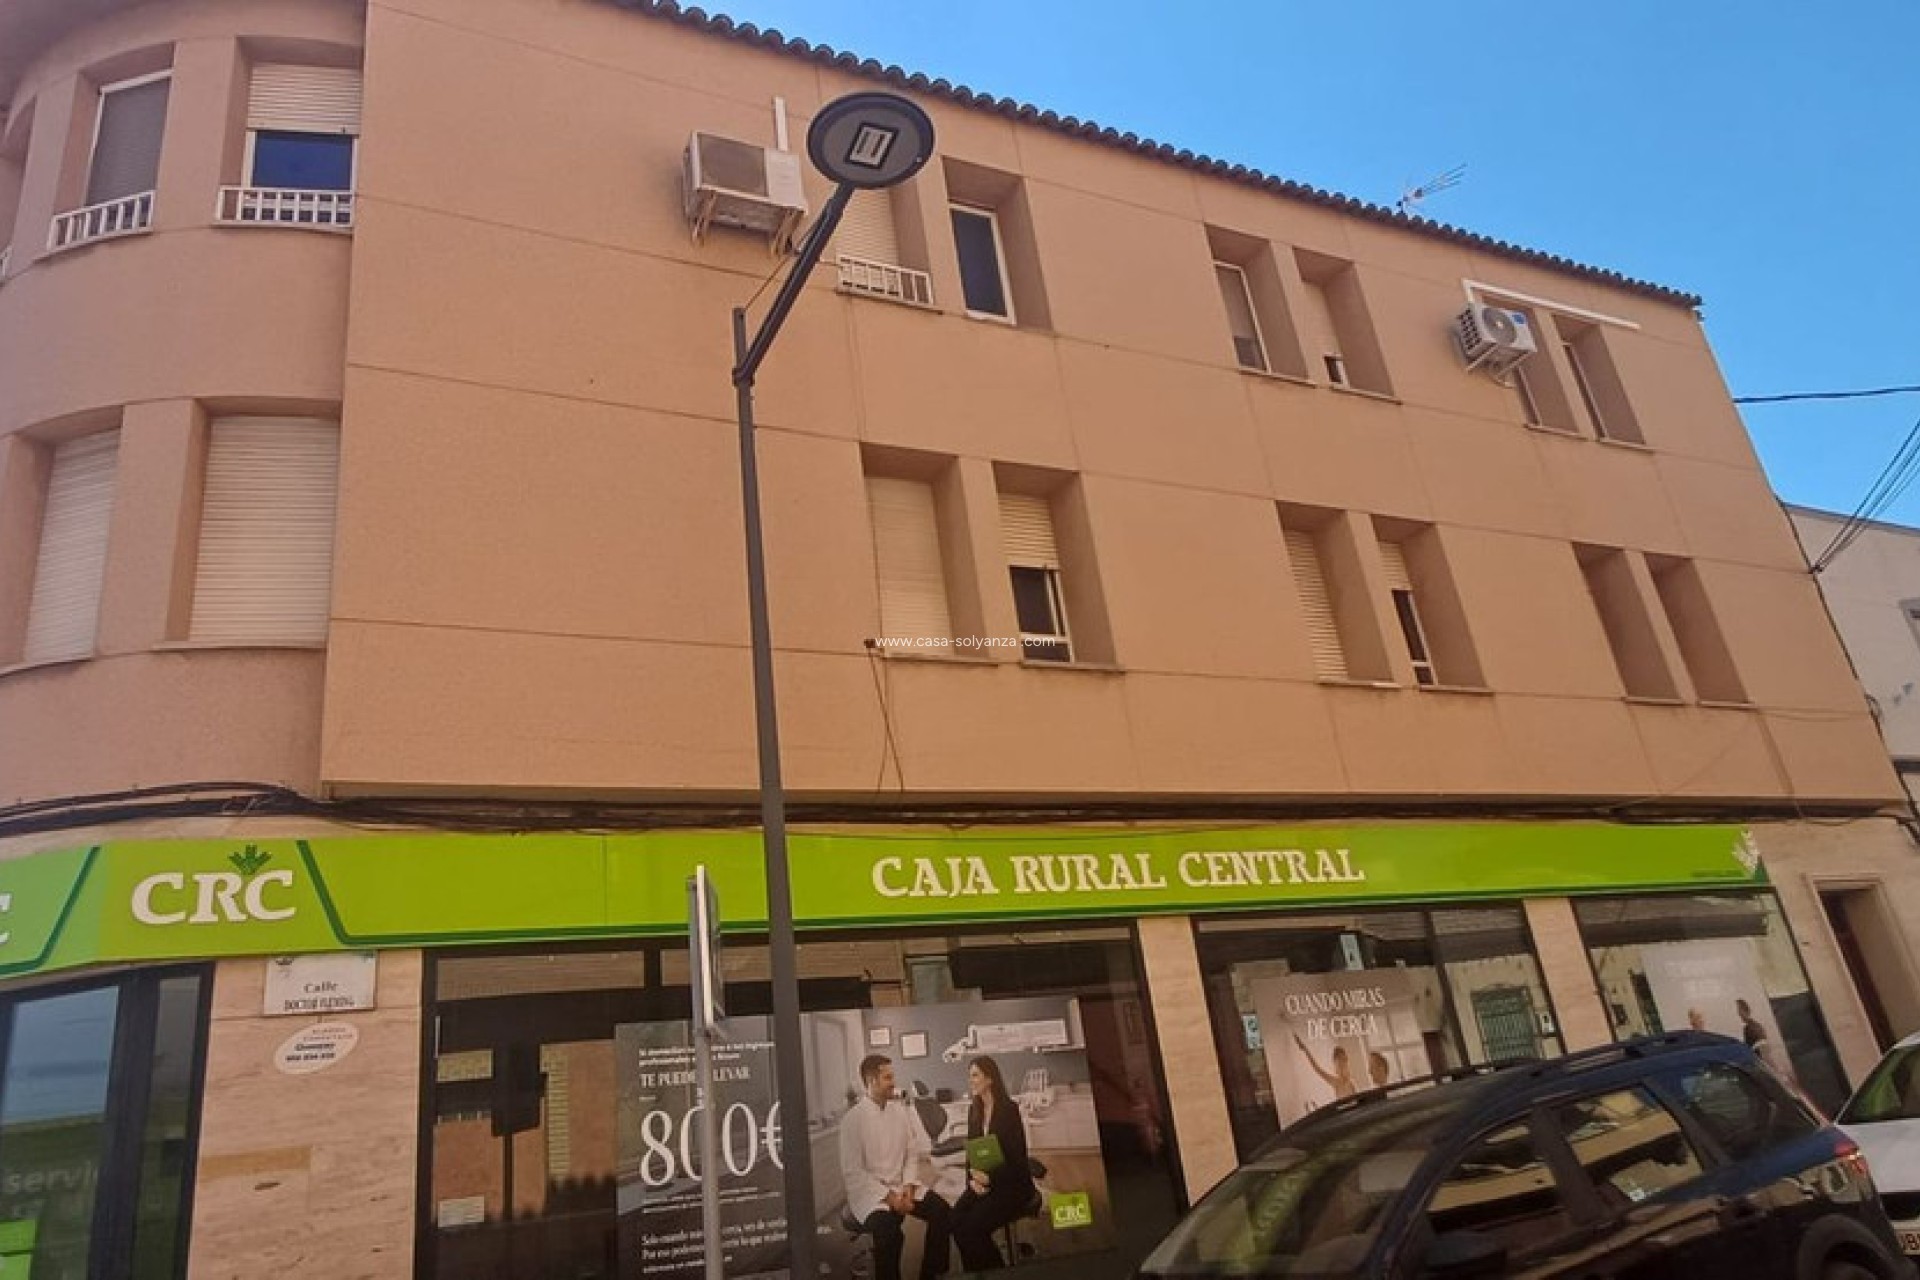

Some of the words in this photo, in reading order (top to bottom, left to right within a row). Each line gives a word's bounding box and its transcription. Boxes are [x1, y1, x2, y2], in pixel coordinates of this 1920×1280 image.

[872, 857, 1000, 898] CAJA
[1009, 853, 1167, 893] RURAL
[1177, 848, 1366, 887] CENTRAL
[131, 870, 297, 924] CRC
[1284, 992, 1341, 1016] CUANDO
[1306, 1018, 1329, 1039] DE
[1331, 1013, 1378, 1038] CERCA
[640, 1073, 656, 1088] TE
[1, 1161, 98, 1194] servi
